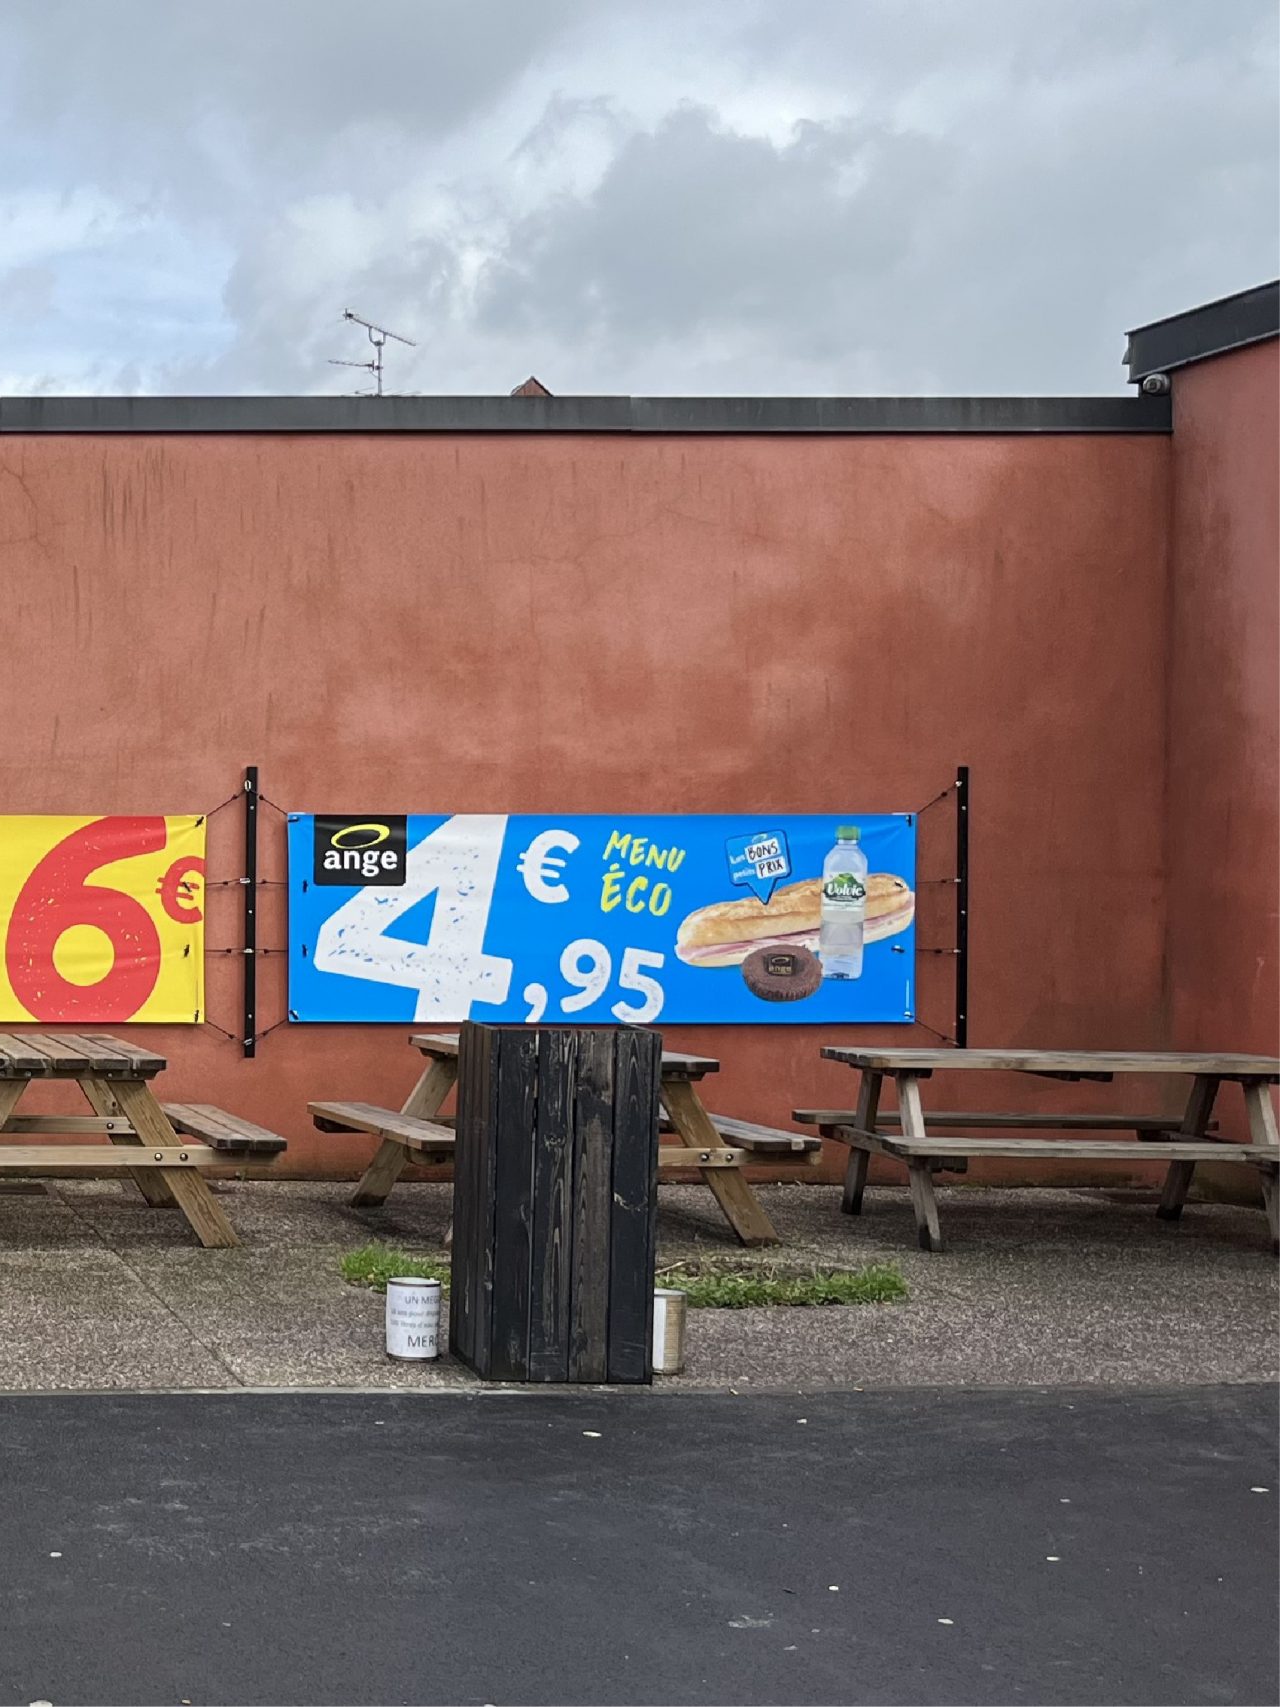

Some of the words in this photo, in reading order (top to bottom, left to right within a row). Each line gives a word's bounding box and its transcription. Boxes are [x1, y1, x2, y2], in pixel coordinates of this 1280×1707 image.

[602, 830, 686, 873] MENU
[747, 841, 779, 861] BONS
[323, 849, 398, 877] ange
[758, 859, 784, 877] PRIX
[600, 863, 672, 917] ÉCO
[827, 881, 863, 897] Volvic
[405, 1296, 419, 1304] UN
